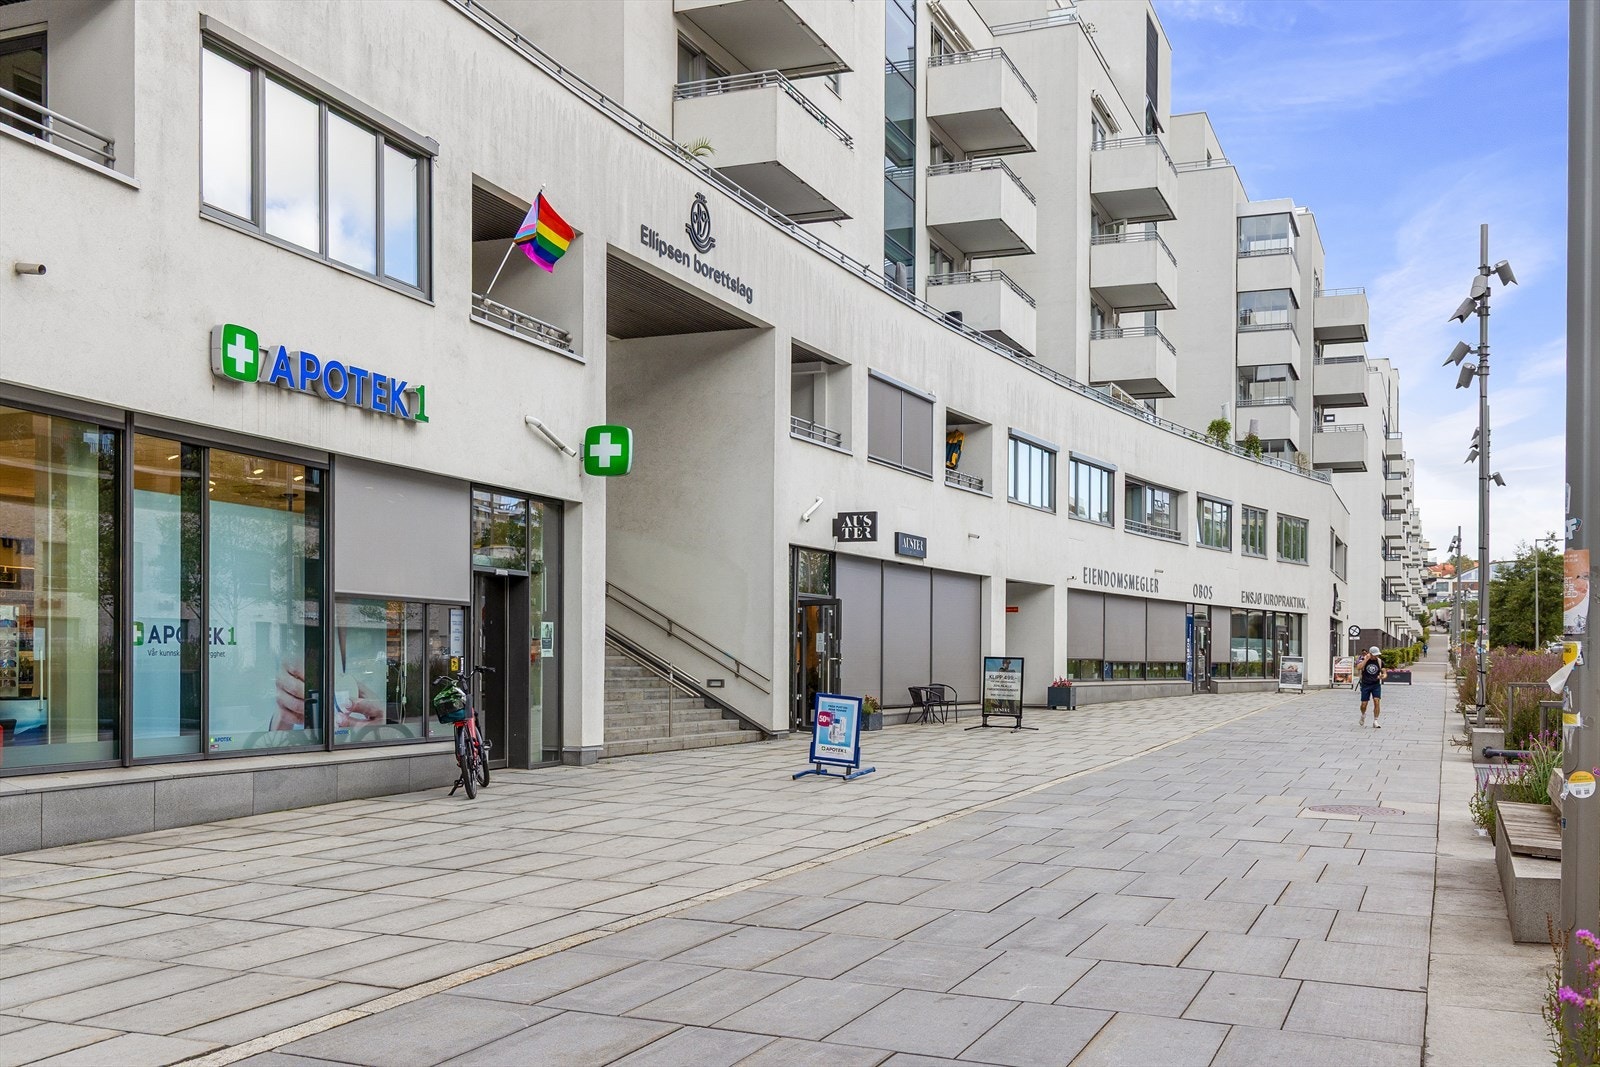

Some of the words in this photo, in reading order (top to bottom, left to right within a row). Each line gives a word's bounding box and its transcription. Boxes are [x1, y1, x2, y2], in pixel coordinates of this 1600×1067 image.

[640, 223, 690, 268] Ellipsen
[693, 253, 753, 305] borettslag
[269, 344, 410, 418] APOTEK
[414, 384, 430, 423] 1
[841, 514, 872, 527] AUS
[841, 527, 872, 539] TER
[902, 537, 924, 551] AUSTER
[1082, 566, 1159, 594] EIENDOMSMEGLER
[1192, 583, 1213, 600] OBOS
[1241, 590, 1262, 605] ENSJØ
[1263, 593, 1306, 609] KIROPRAKTIKK
[147, 624, 225, 646] APK
[227, 626, 238, 646] 1
[147, 647, 158, 657] Vår
[160, 649, 180, 657] kunnsk
